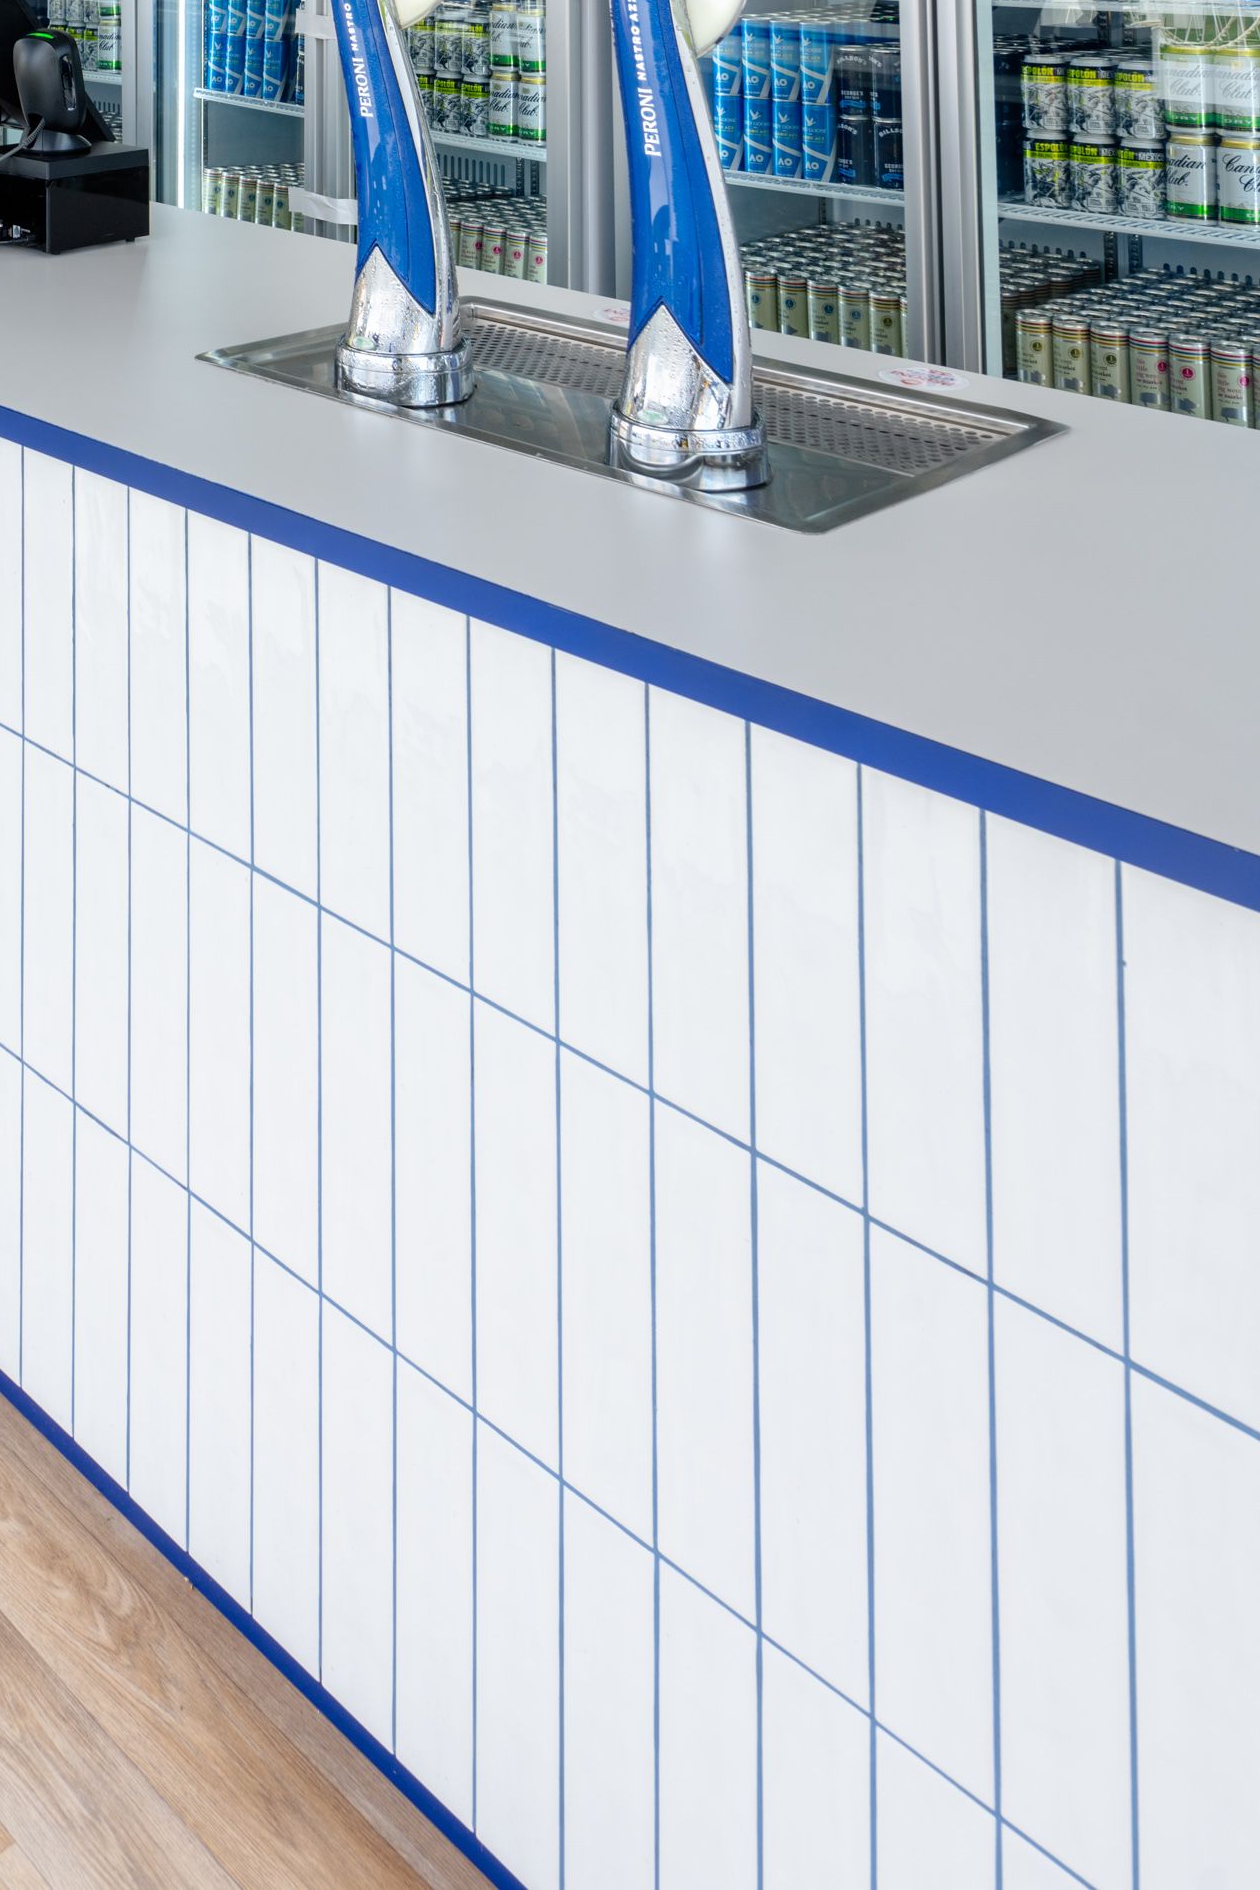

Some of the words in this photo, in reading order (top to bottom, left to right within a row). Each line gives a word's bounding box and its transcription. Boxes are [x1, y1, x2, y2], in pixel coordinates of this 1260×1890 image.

[344, 3, 359, 51] NASTRO
[630, 26, 647, 81] NASTRO
[352, 58, 374, 118] PERONI
[638, 87, 662, 158] PERONI
